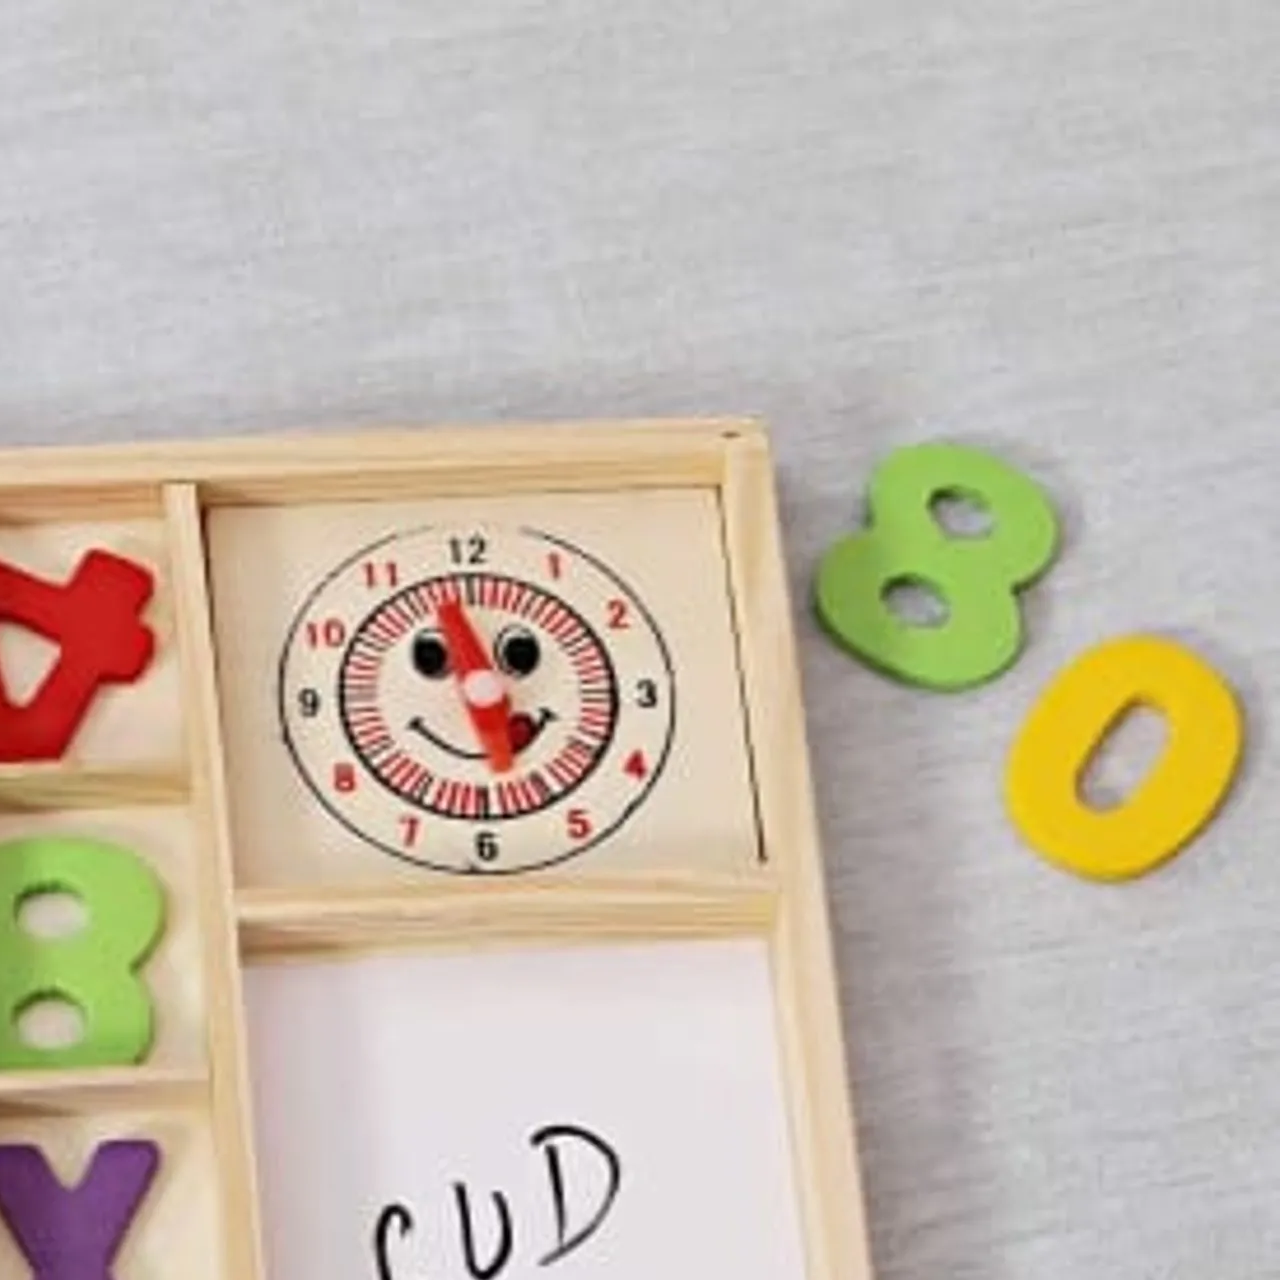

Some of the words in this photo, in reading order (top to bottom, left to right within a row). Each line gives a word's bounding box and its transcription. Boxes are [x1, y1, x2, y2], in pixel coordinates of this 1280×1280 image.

[450, 536, 486, 564] 12
[549, 548, 564, 579] 1
[365, 562, 397, 588] 11
[813, 442, 1060, 692] 8
[609, 597, 632, 629] 2
[303, 619, 345, 648] 10
[298, 688, 320, 717] 9
[637, 679, 658, 708] 3
[335, 765, 355, 792] 8
[624, 750, 648, 783] 4
[401, 817, 419, 846] 7
[568, 810, 593, 840] 5
[476, 832, 498, 861] 6
